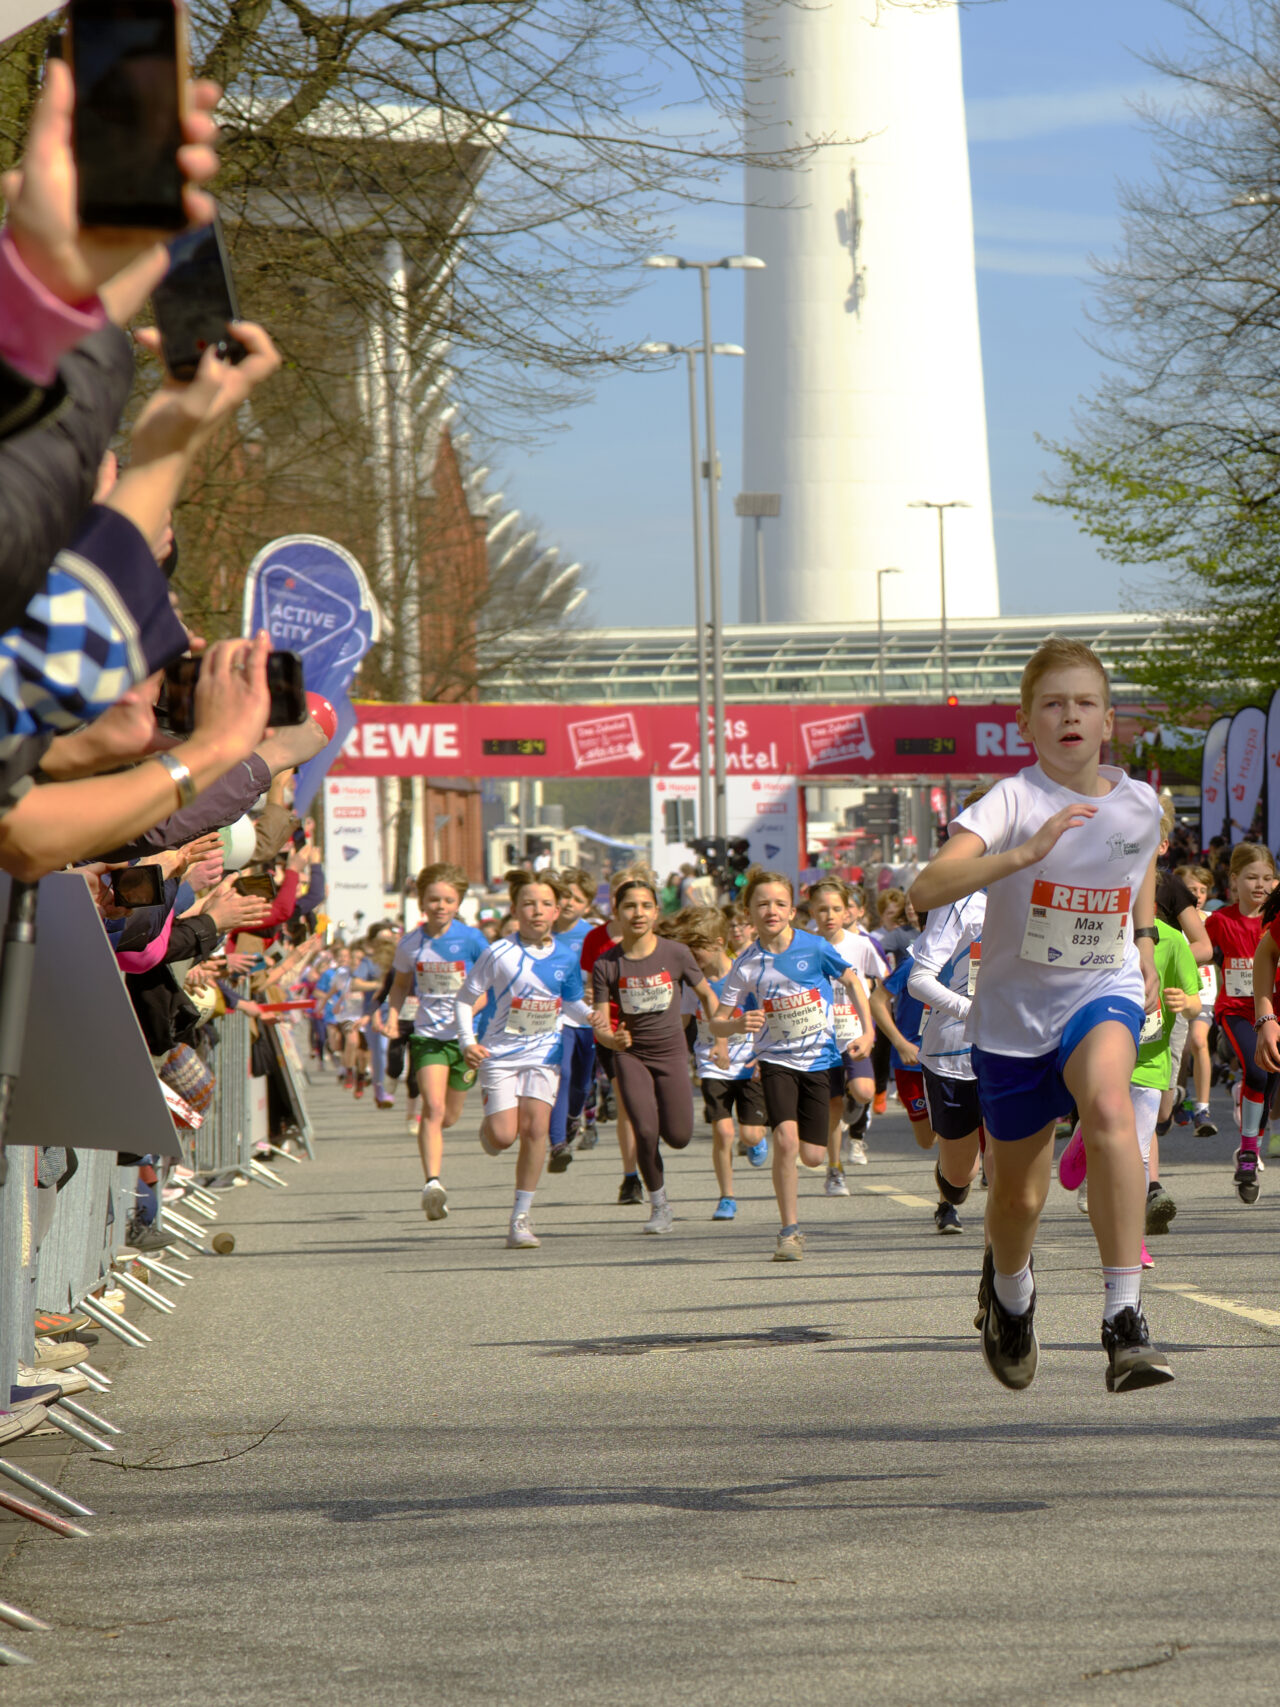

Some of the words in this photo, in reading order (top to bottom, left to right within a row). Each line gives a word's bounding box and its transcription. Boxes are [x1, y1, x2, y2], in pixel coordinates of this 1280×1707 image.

[271, 603, 336, 628] ACTIVE
[271, 621, 312, 642] CITY
[1051, 886, 1120, 912] REWE
[1075, 917, 1103, 931] Max
[1071, 934, 1100, 946] 8239
[1117, 929, 1124, 940] A
[1092, 954, 1115, 965] asics
[1231, 958, 1254, 969] REW
[521, 1000, 556, 1011] REWE
[772, 992, 812, 1011] REWE
[777, 1006, 817, 1021] Frederike
[833, 1005, 851, 1015] WE
